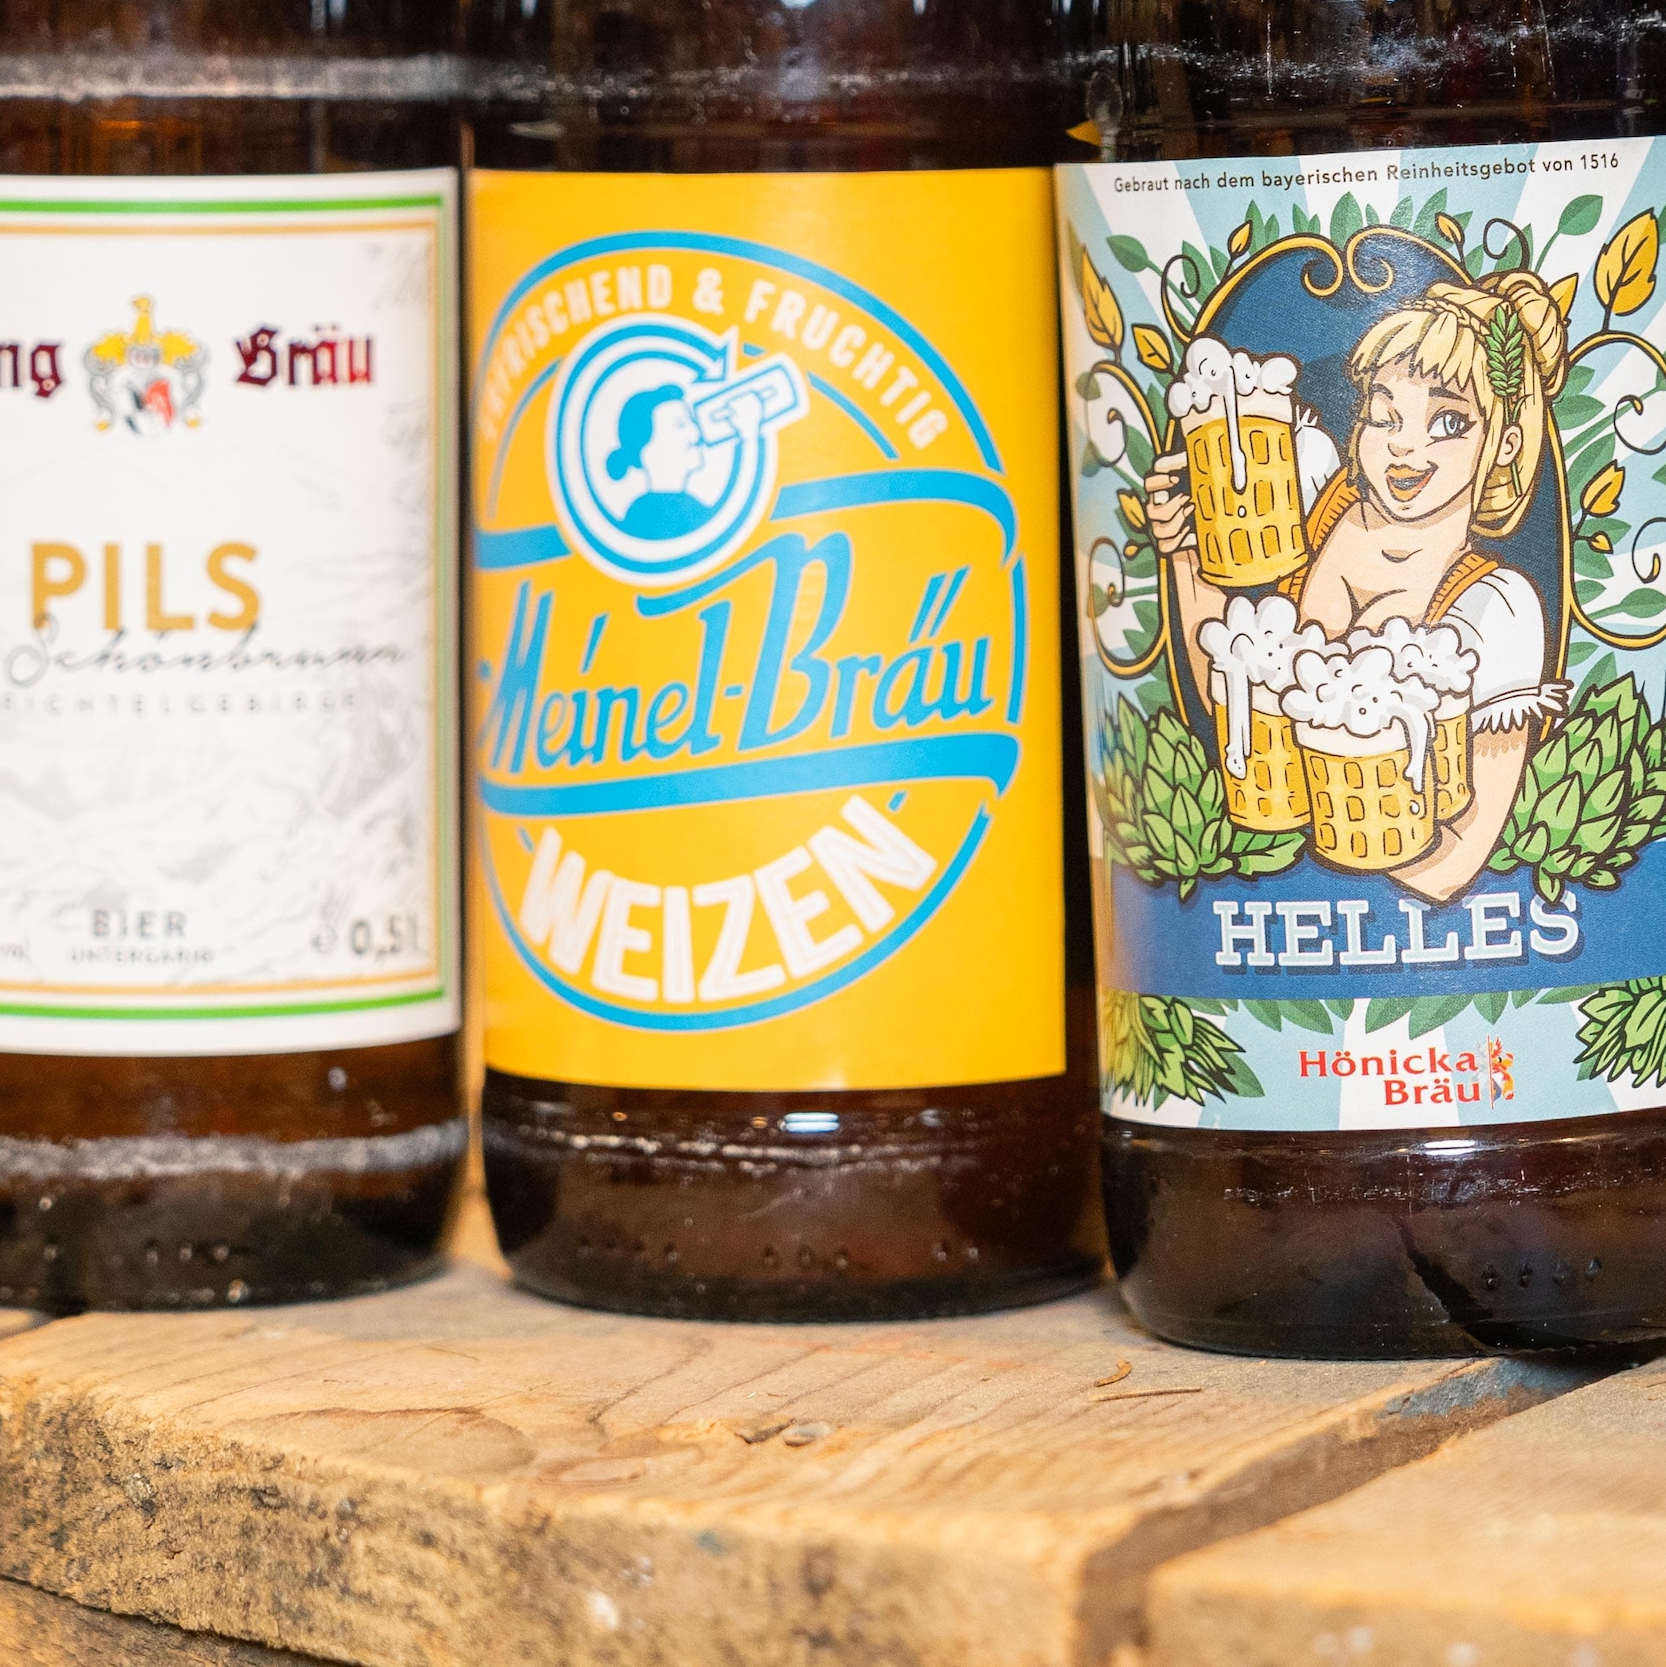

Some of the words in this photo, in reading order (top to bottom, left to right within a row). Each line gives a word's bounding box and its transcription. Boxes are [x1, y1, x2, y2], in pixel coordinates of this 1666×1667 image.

[1114, 174, 1170, 194] Gebraut
[1174, 172, 1211, 192] nach
[1216, 170, 1256, 189] dem
[1261, 165, 1378, 193] bayerischen
[1386, 159, 1536, 182] Reinheitsgebot
[1542, 157, 1574, 173] von
[1580, 152, 1620, 173] 1516
[234, 324, 377, 389] Bräu
[692, 267, 725, 314] &
[743, 279, 949, 450] FRUCHTIG
[30, 541, 263, 632] PILS
[477, 531, 996, 775] Meinel-Bräu
[91, 909, 188, 939] BIER
[518, 795, 938, 1005] WEIZEN
[1212, 892, 1581, 972] HELLES
[1298, 1043, 1479, 1080] Hönicka
[1383, 1071, 1482, 1107] Bräu
